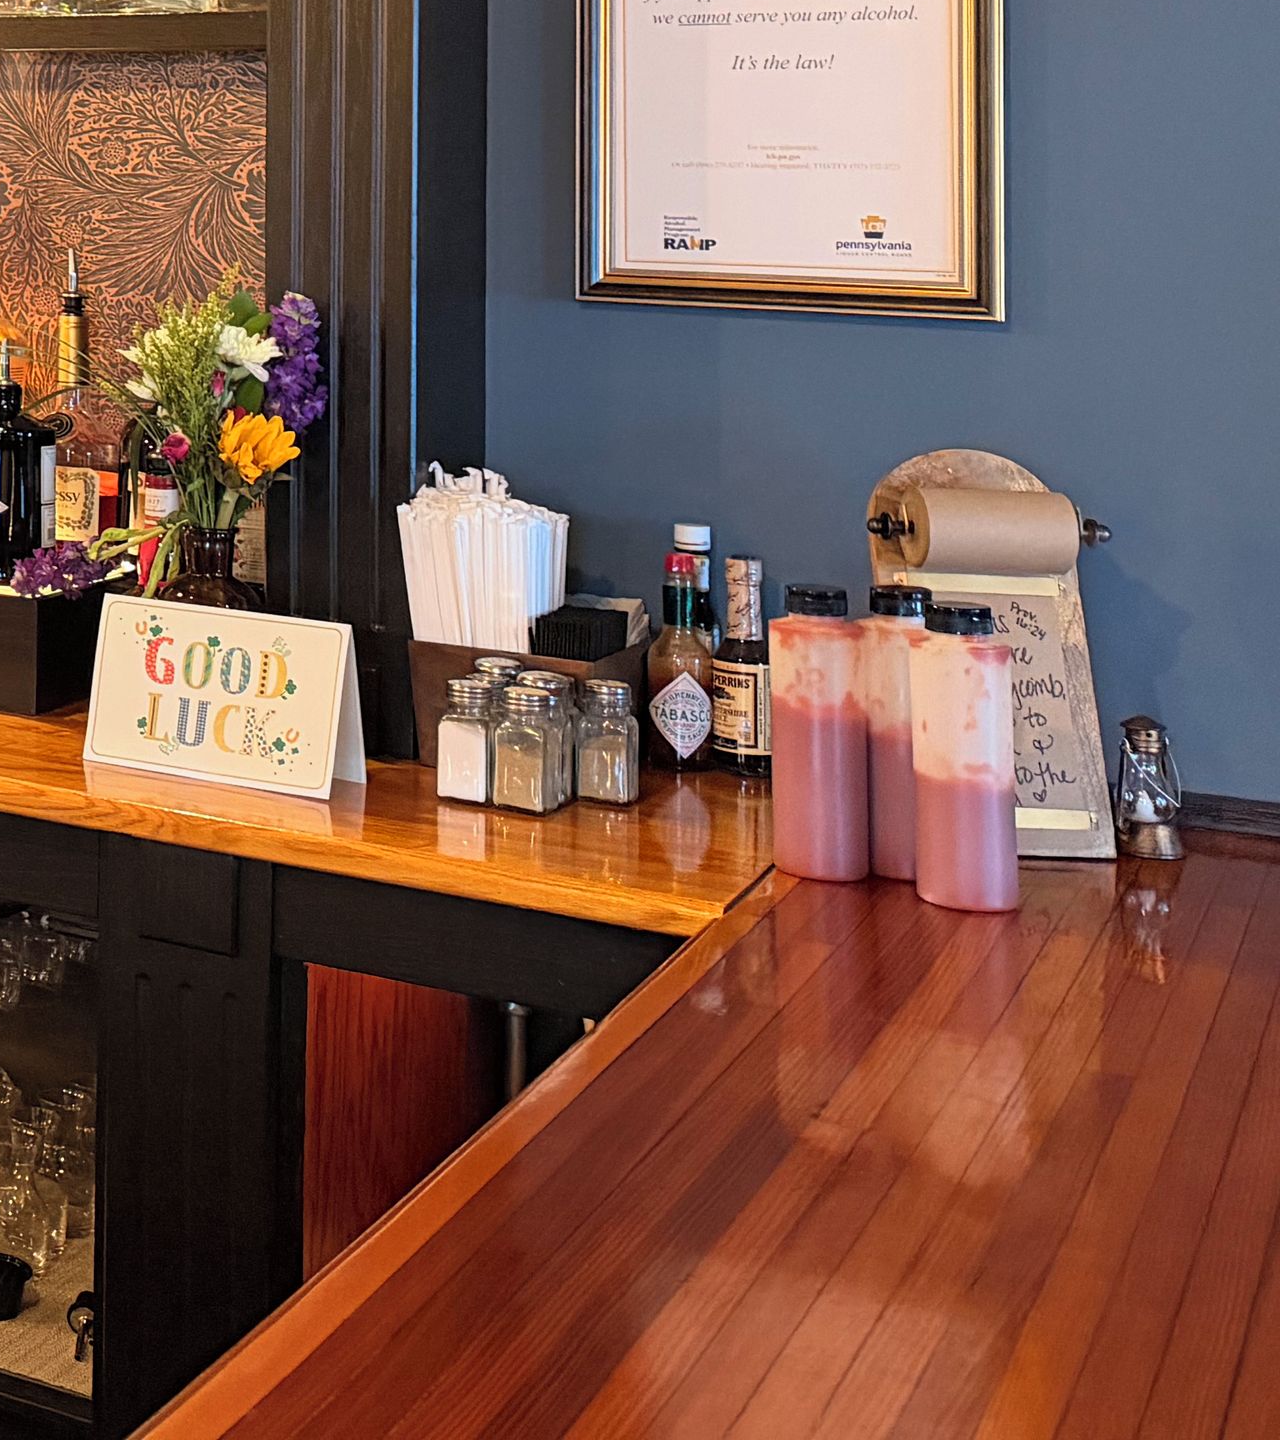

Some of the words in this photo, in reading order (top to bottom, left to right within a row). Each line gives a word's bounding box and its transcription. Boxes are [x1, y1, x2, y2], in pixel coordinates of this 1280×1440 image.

[652, 14, 674, 24] we
[678, 12, 732, 26] cannot
[735, 11, 778, 23] serve
[780, 11, 811, 26] you
[816, 10, 847, 25] any
[851, 5, 918, 21] alcohol.
[731, 54, 758, 70] It's
[763, 54, 790, 70] the
[795, 53, 835, 70] law!
[664, 237, 717, 251] RAMP
[836, 240, 912, 252] pennsylvania
[1010, 601, 1038, 623] Prov.
[1015, 616, 1047, 640] 16:24
[144, 635, 289, 700] GOOD
[714, 674, 751, 689] PERRINS
[651, 705, 711, 723] TABASCO
[1023, 707, 1047, 728] to
[143, 692, 277, 759] LUCK
[1032, 762, 1077, 788] the
